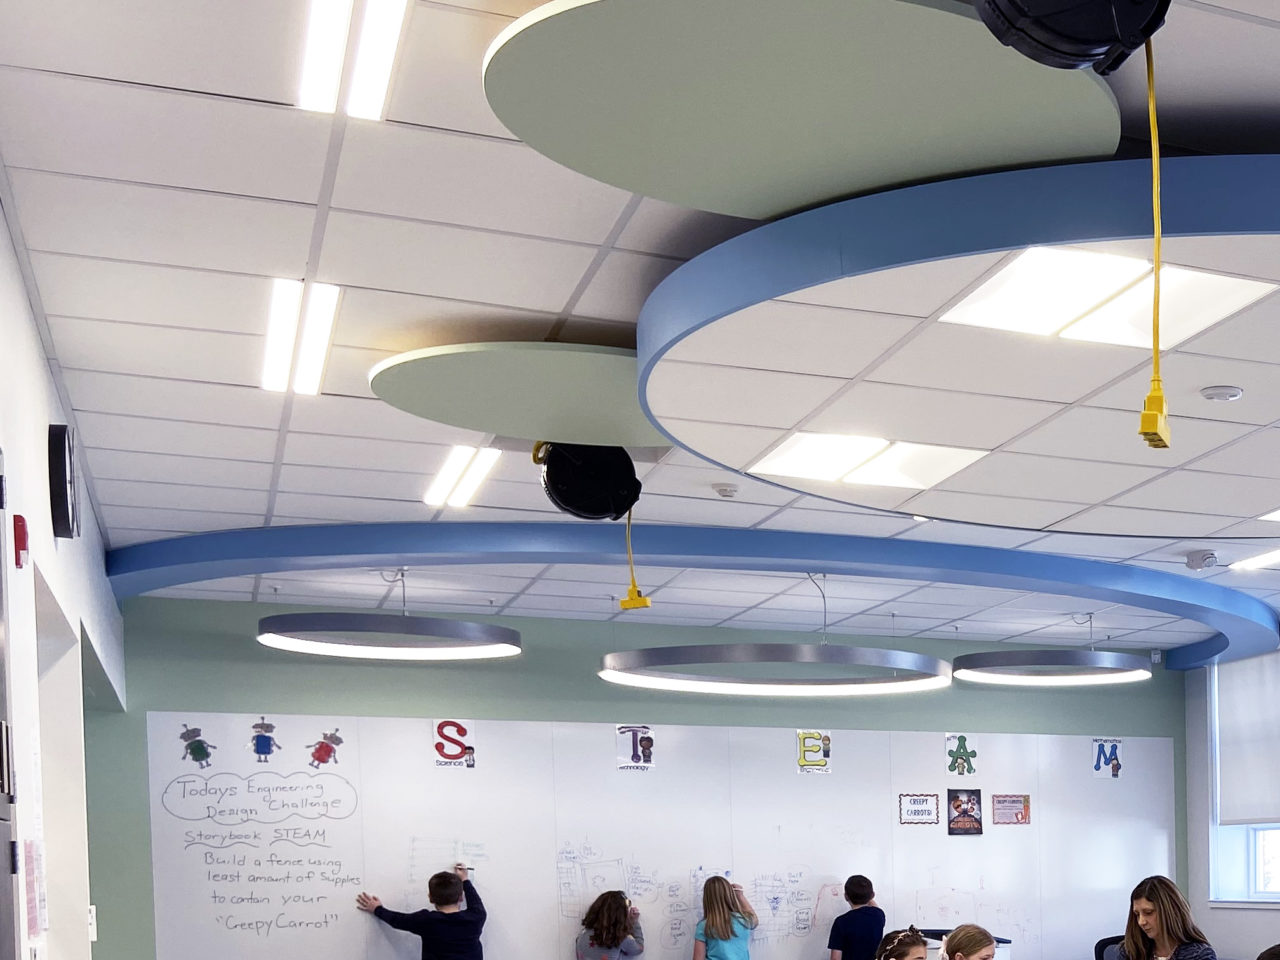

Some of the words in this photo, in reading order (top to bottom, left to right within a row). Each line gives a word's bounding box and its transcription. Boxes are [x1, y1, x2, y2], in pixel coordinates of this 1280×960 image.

[435, 720, 467, 760] S
[798, 732, 827, 767] E
[948, 735, 977, 774] A
[1094, 743, 1121, 771] M
[177, 780, 238, 804] Todays
[247, 780, 324, 803] Engineering
[207, 805, 258, 823] Design
[268, 799, 342, 816] Challenge
[185, 830, 262, 845] Storybook
[273, 829, 326, 842] STEAM
[204, 852, 246, 866] Build
[254, 859, 261, 867] a
[266, 853, 304, 866] fence
[308, 858, 342, 875] using
[207, 870, 240, 882] least
[248, 871, 292, 884] amount
[296, 872, 315, 884] of
[211, 890, 225, 903] to
[281, 895, 327, 906] your
